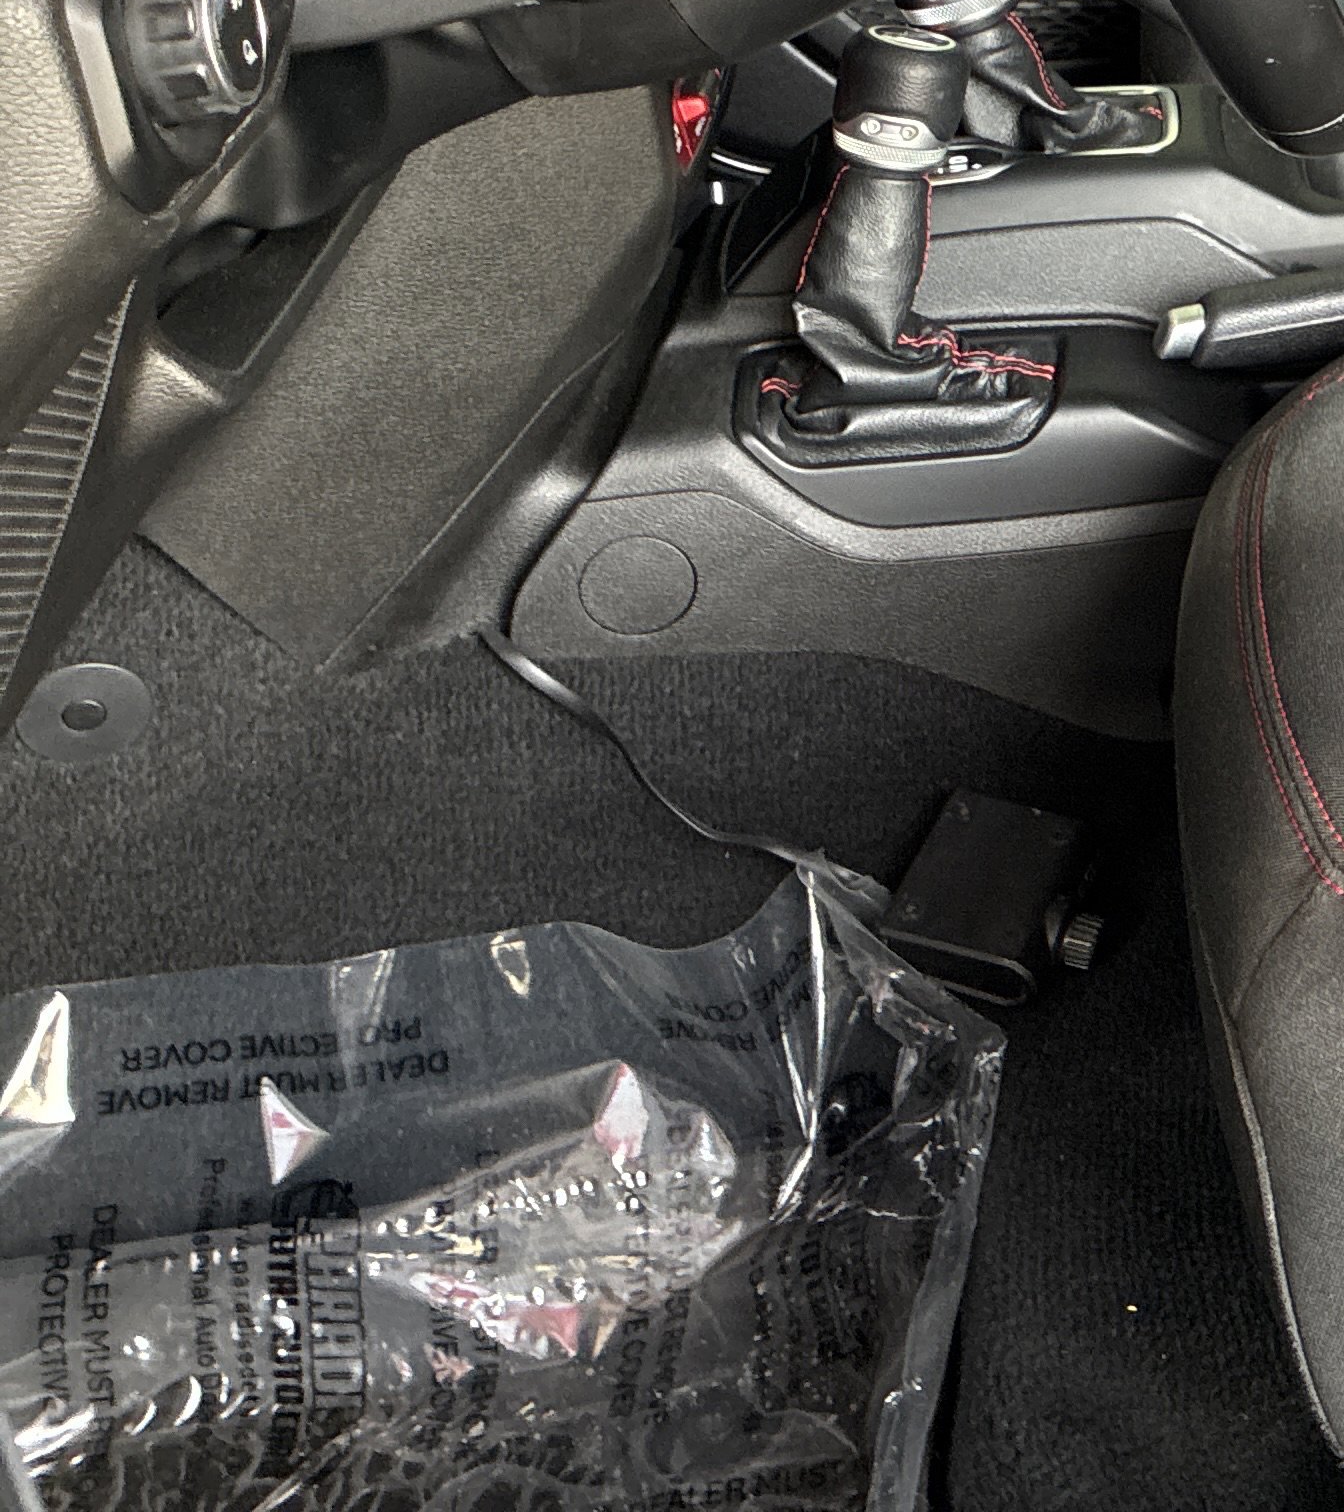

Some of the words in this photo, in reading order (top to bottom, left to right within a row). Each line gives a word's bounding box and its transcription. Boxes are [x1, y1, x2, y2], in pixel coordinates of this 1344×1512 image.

[120, 1039, 232, 1072] COVER
[240, 1015, 423, 1061] PROECTIVE
[328, 1049, 451, 1092] DEALER
[98, 1078, 231, 1114] REMOVE
[81, 1204, 118, 1322] DEALER
[38, 1233, 74, 1401] PROTECTIV
[82, 1330, 115, 1406] MUST
